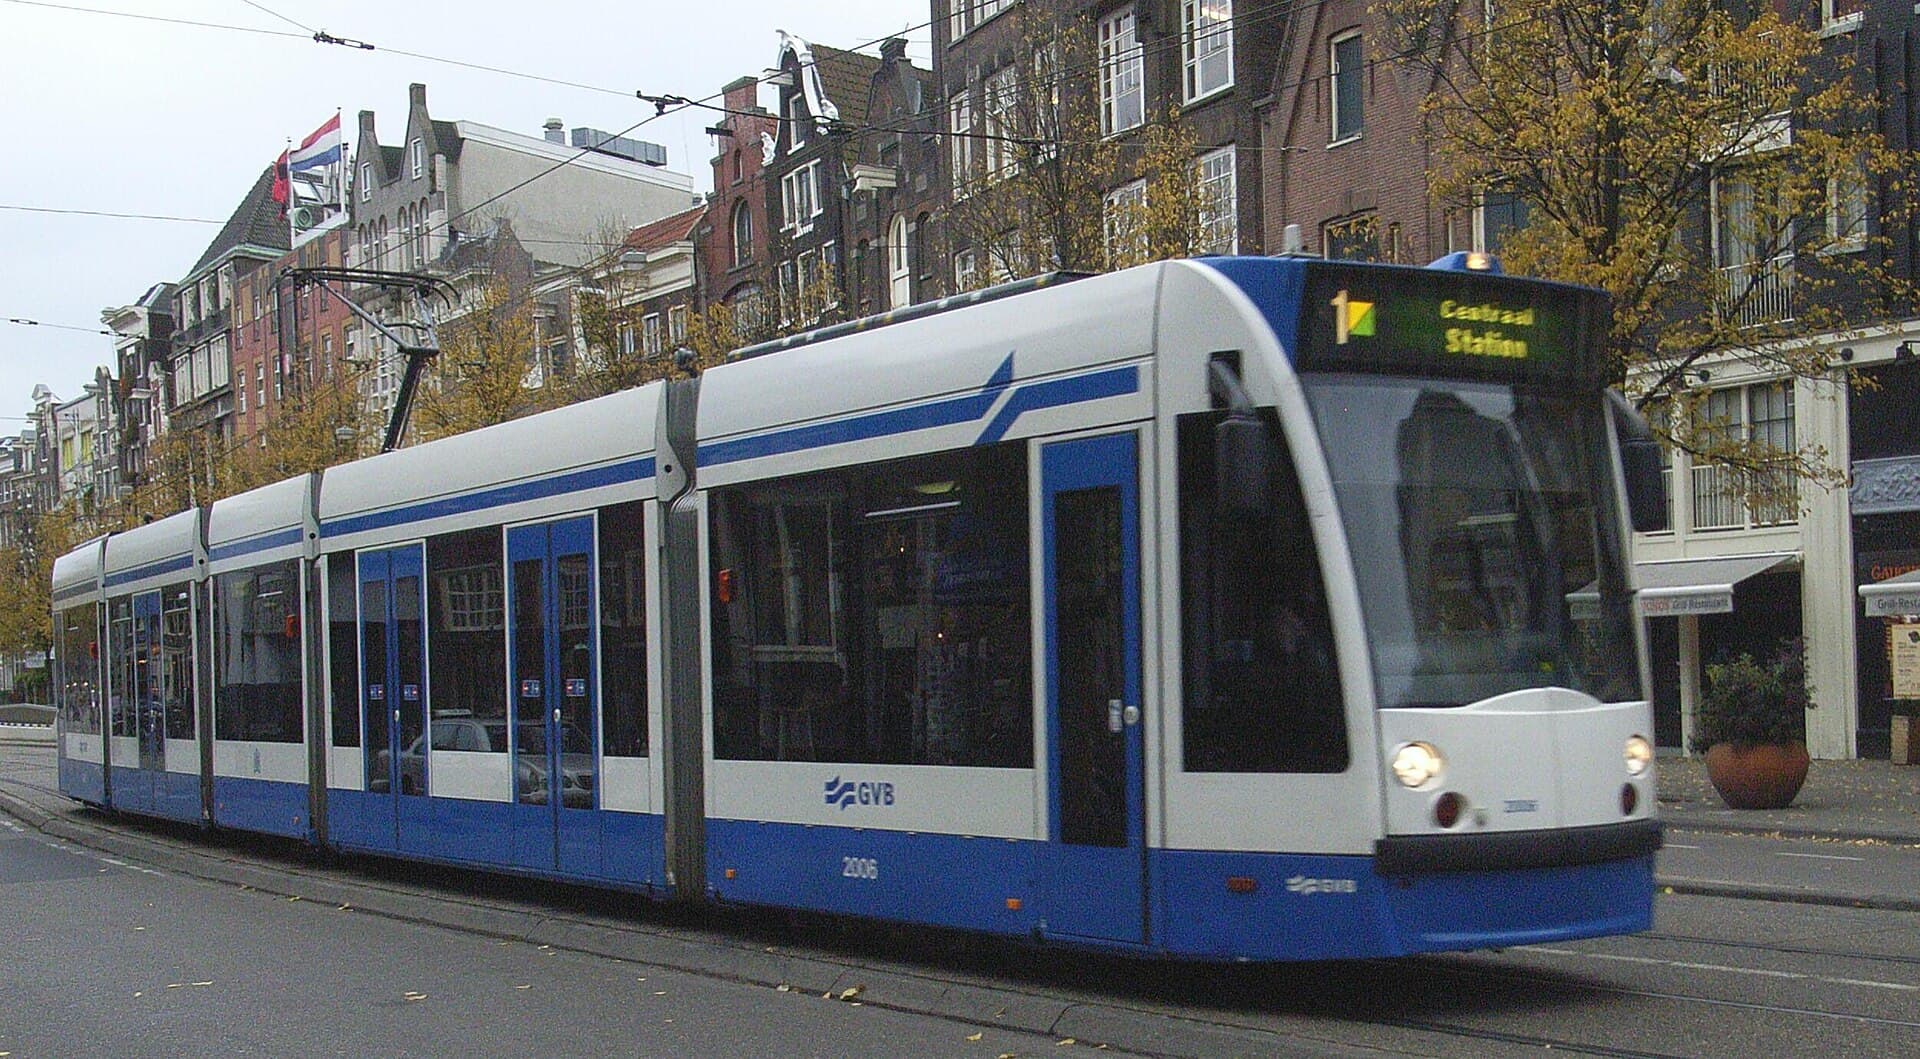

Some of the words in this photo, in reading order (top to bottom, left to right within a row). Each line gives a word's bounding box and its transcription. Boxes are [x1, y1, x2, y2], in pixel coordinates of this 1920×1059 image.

[1331, 289, 1349, 344] 1
[1445, 327, 1528, 359] Station
[858, 782, 895, 806] GVB
[842, 856, 879, 880] 2006
[1320, 878, 1358, 894] GVB
